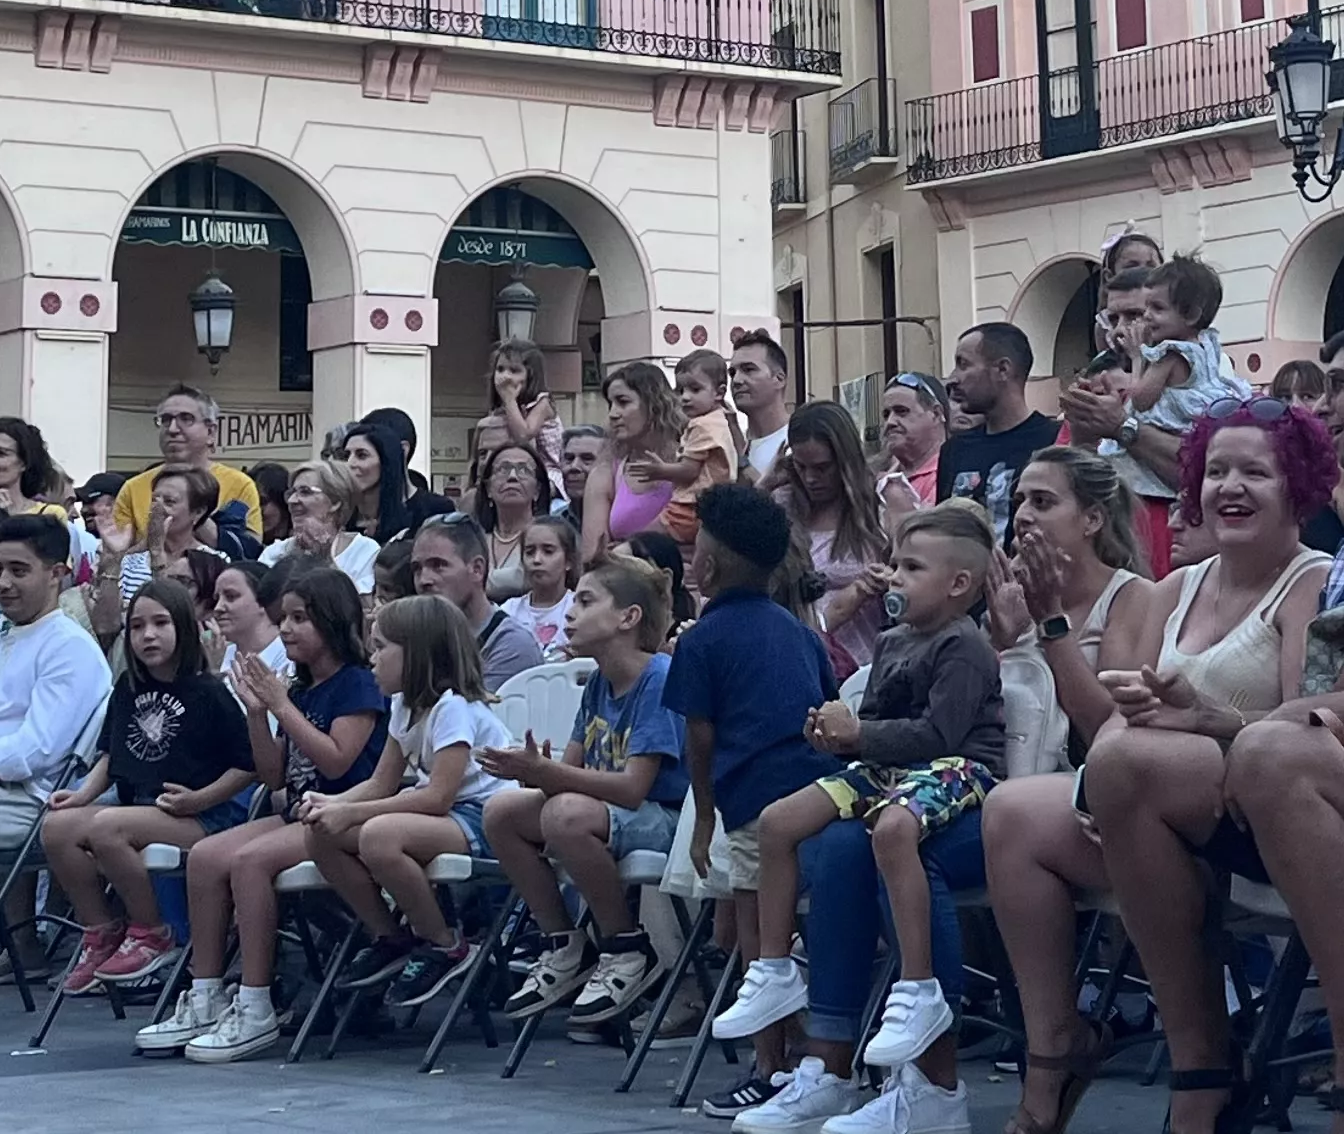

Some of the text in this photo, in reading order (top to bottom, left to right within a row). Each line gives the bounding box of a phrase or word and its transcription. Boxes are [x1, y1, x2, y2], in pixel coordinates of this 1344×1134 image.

[181, 216, 269, 245] LA CONFIANZA
[458, 235, 527, 259] desde 1871
